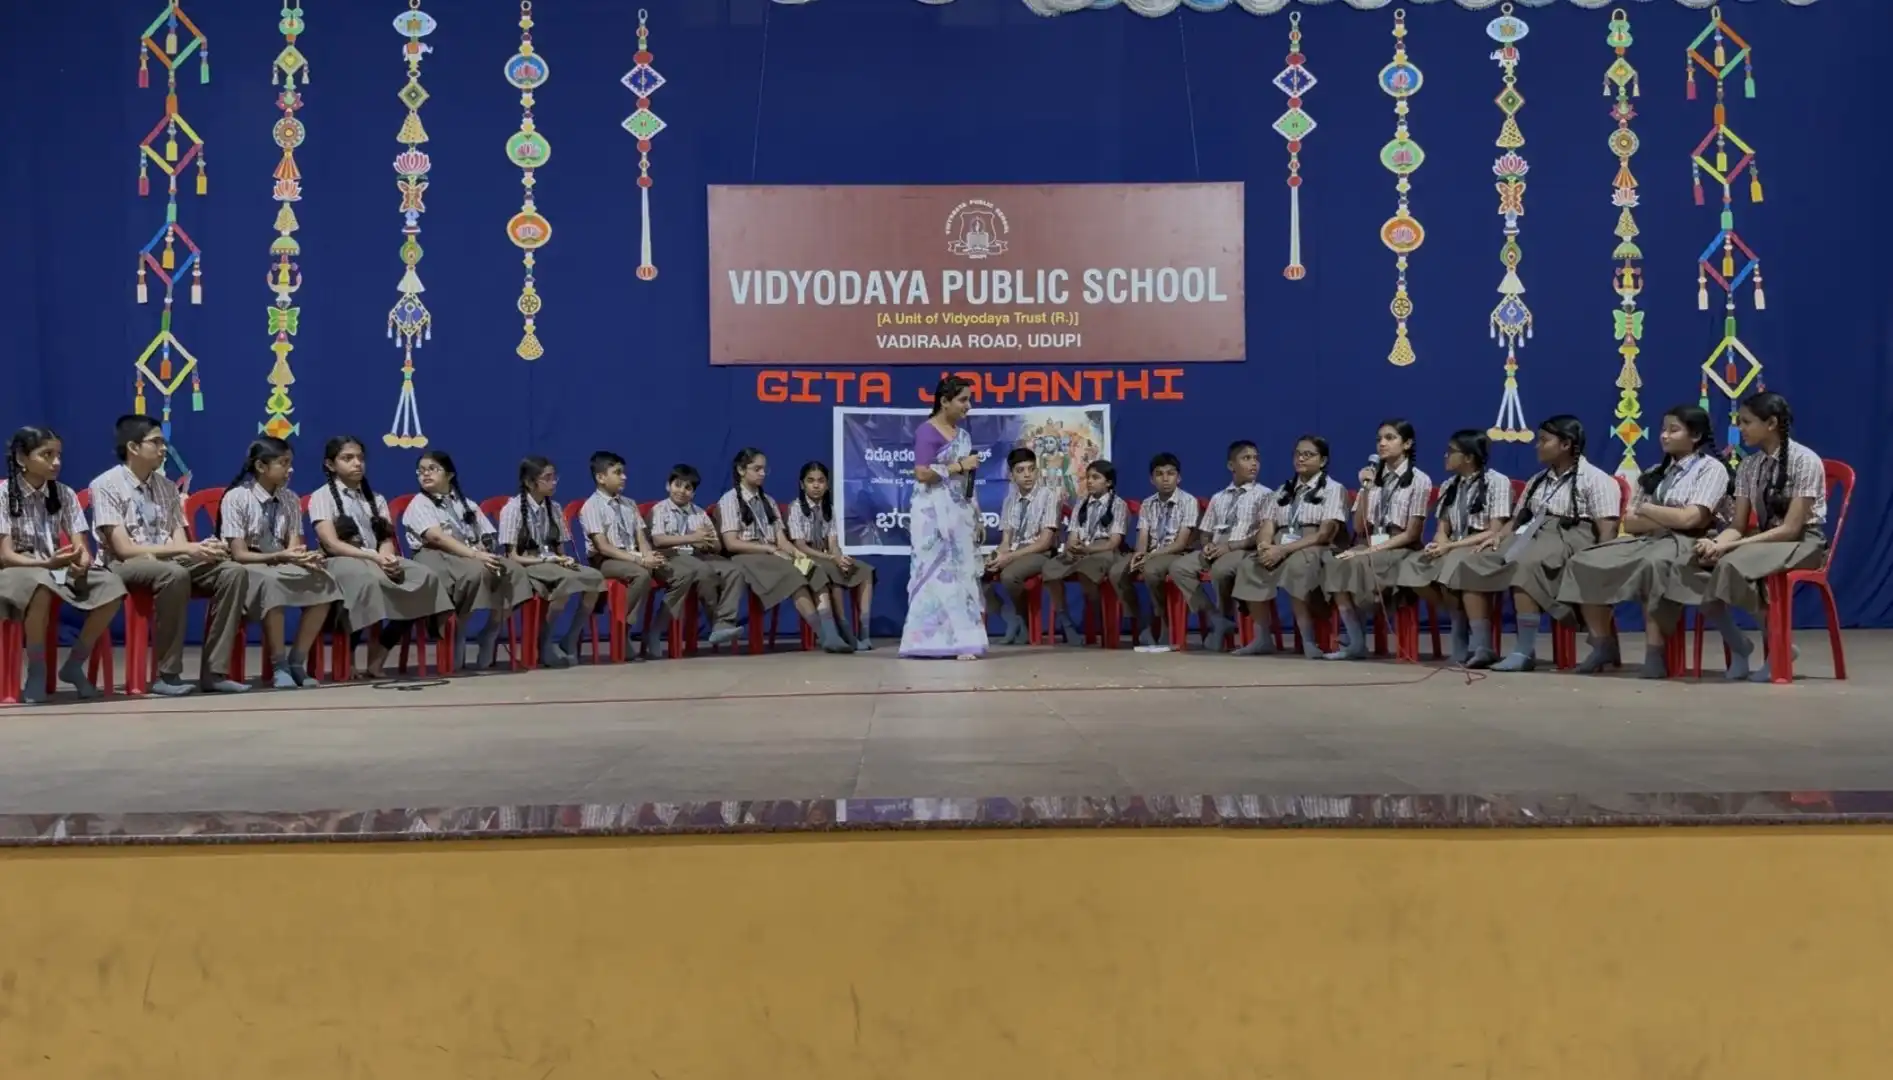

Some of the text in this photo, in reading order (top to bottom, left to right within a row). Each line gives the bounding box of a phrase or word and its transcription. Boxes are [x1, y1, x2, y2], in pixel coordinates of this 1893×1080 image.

[728, 266, 1227, 306] VIDYODAYA PUBLIC SCHOOL
[877, 312, 892, 328] [A
[895, 312, 922, 326] Unit
[926, 312, 939, 325] of
[942, 311, 1010, 327] Vidyodaya
[1014, 311, 1047, 324] Trust
[876, 333, 1082, 350] VADIRAJA ROAD, UDUPI
[757, 370, 892, 403] GITA
